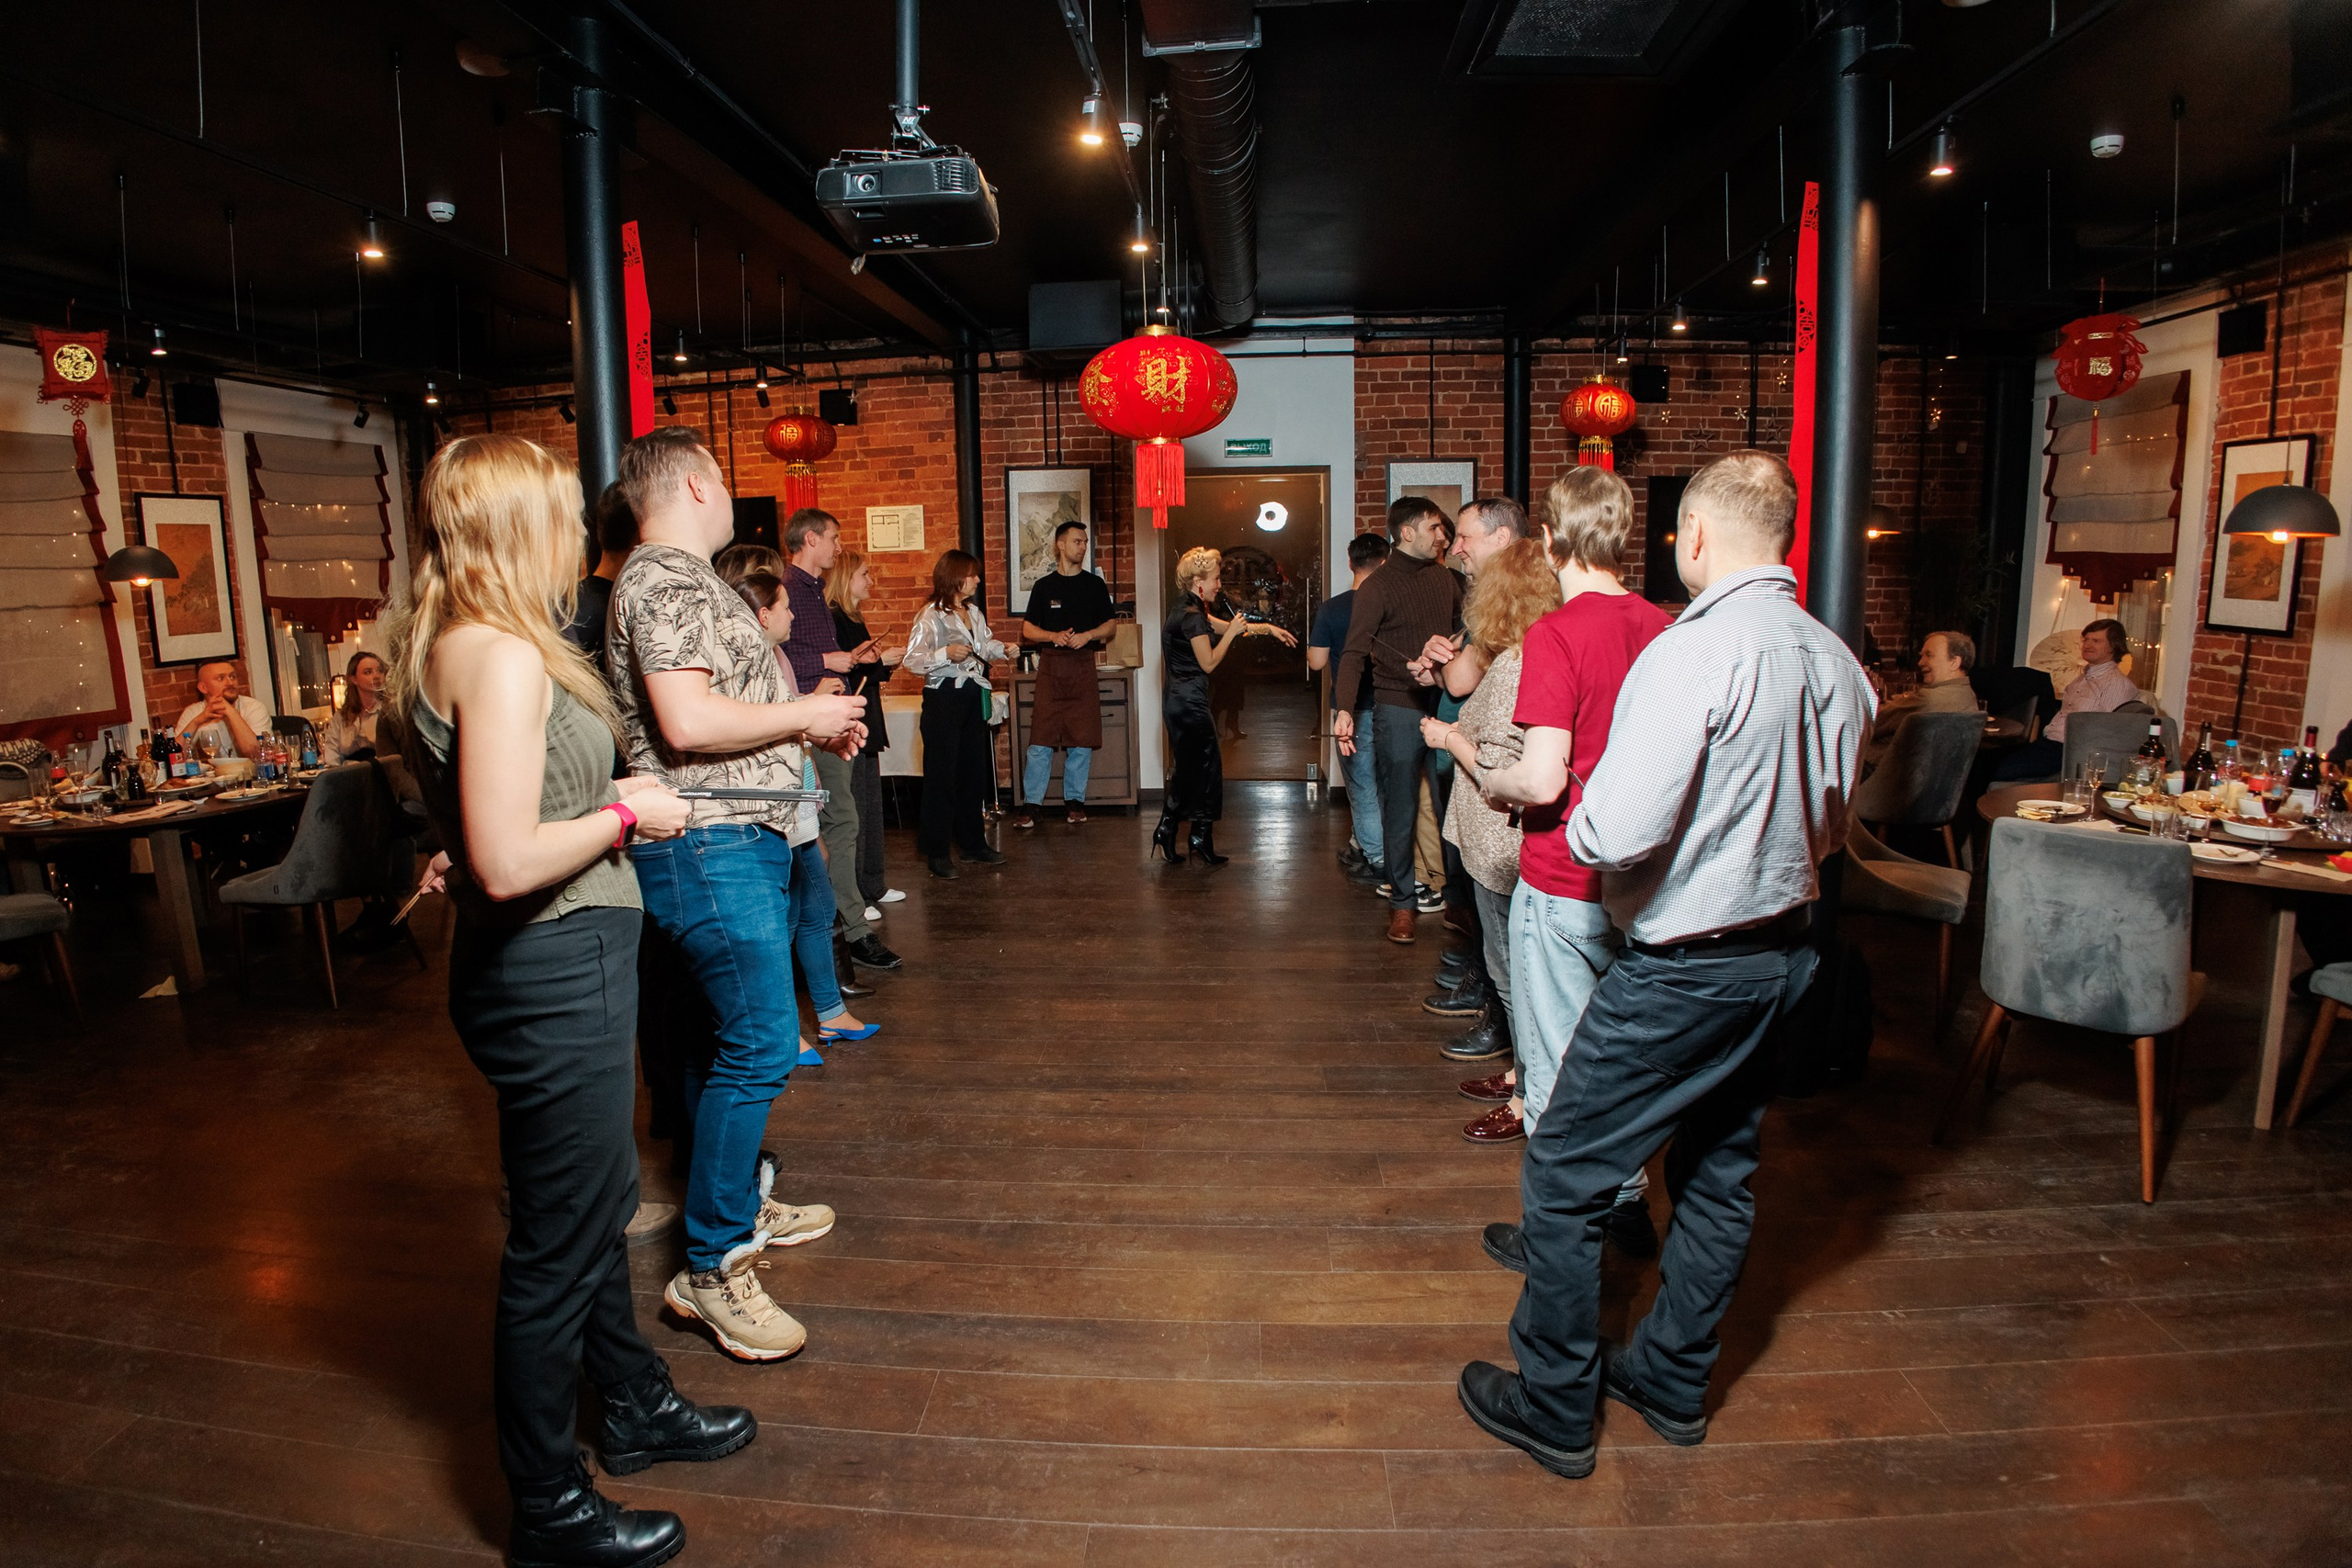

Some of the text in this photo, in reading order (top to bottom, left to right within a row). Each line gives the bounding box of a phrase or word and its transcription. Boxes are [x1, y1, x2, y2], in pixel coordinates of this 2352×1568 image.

[1140, 355, 1192, 404] 財
[1564, 396, 1584, 419] 福
[1600, 393, 1623, 419] 福
[779, 423, 798, 445] 福
